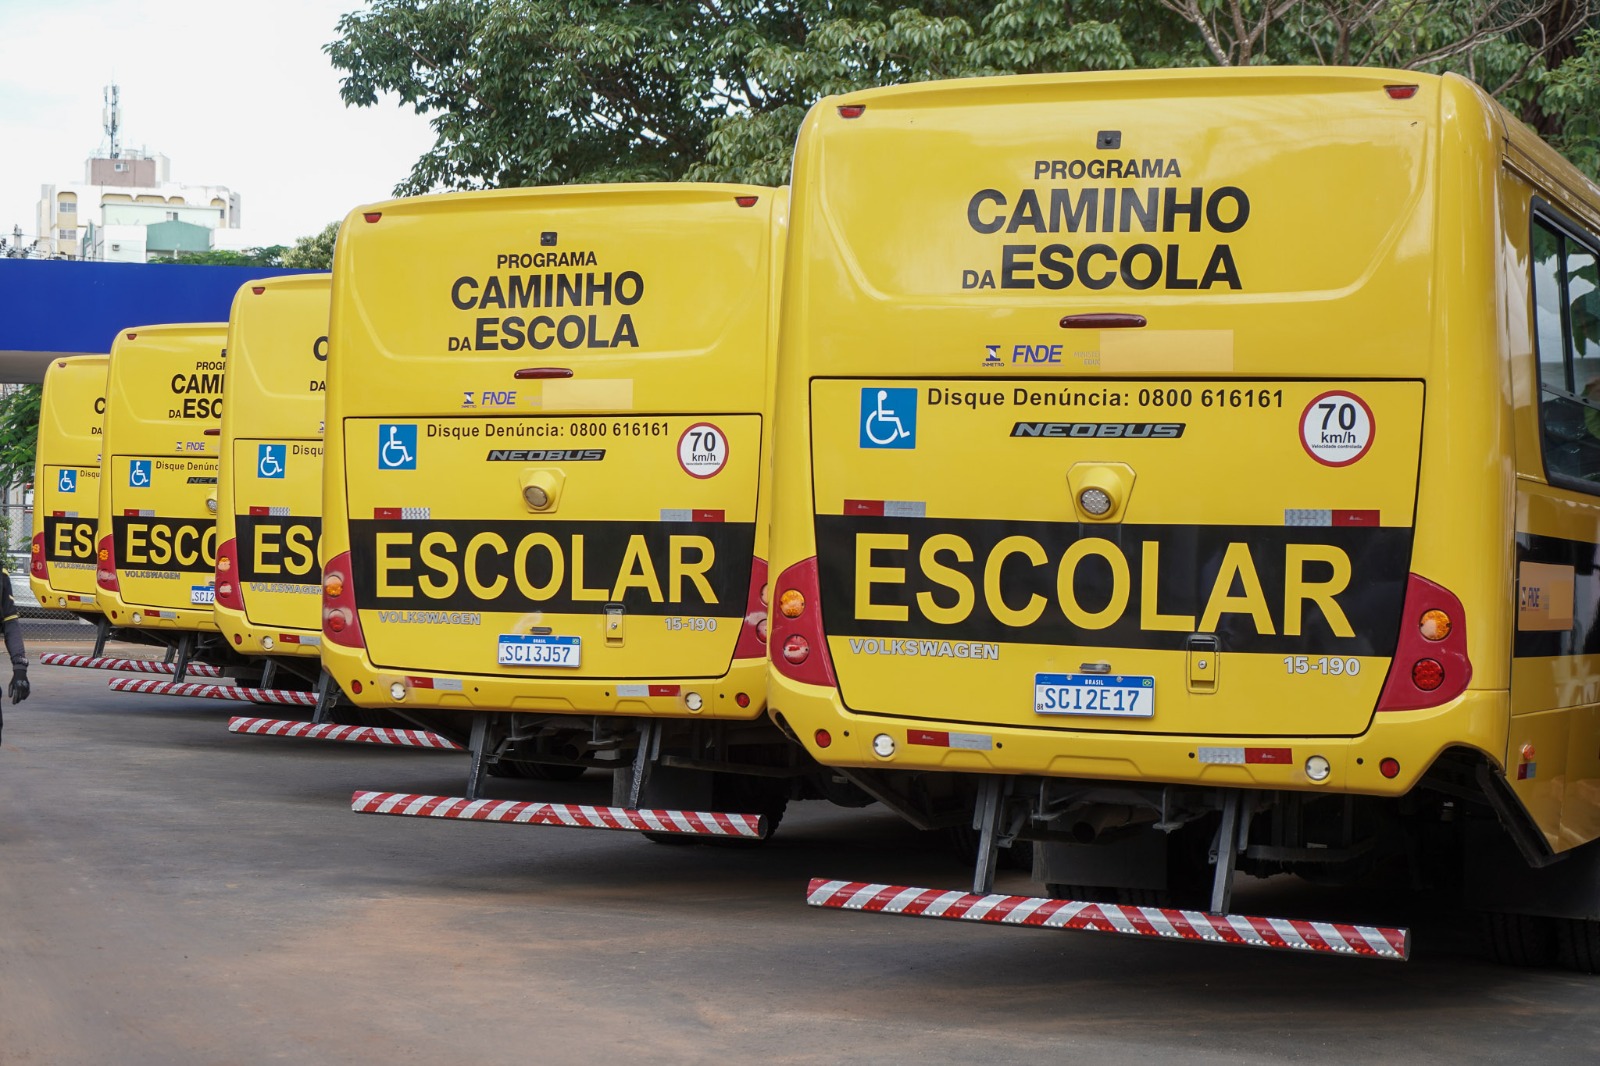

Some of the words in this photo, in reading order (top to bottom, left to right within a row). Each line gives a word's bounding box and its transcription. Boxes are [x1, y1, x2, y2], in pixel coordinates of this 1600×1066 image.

[1034, 158, 1182, 180] PROGRAMA
[967, 186, 1251, 234] CAMINHO
[497, 250, 598, 269] PROGRAMA
[962, 270, 997, 290] DA
[1001, 244, 1243, 290] ESCOLA
[451, 271, 645, 311] CAMINHO
[448, 336, 472, 352] DA
[474, 314, 640, 351] ESCOLA
[1011, 344, 1064, 363] FNDE
[481, 391, 518, 405] FNDE
[927, 387, 1005, 410] Disque
[1013, 387, 1129, 407] Denúncia:
[1138, 388, 1193, 408] 0800
[1201, 389, 1283, 408] 616161
[168, 409, 182, 419] DA
[1318, 403, 1357, 431] 70
[91, 427, 103, 435] DA
[427, 423, 480, 441] Disque
[485, 422, 565, 437] Denúncia:
[570, 422, 607, 437] 0800
[612, 421, 669, 437] 616161
[1013, 423, 1183, 438] NEOBUS
[1321, 431, 1356, 443] km/h
[690, 431, 716, 452] 70
[489, 450, 602, 461] NEOBUS
[692, 452, 716, 462] km/h
[155, 461, 185, 472] Disque
[124, 570, 181, 580] VOLKSWAGEN
[374, 531, 720, 605] ESCOLAR
[853, 532, 1356, 639] ESCOLAR
[378, 611, 481, 625] VOLKSWAGEN
[665, 617, 717, 632] 15-190
[505, 645, 571, 663] SCI3J57
[849, 638, 1000, 661] VOLKSWAGEN
[1283, 655, 1361, 677] 15-190
[1084, 678, 1104, 686] BRASIL
[1044, 687, 1140, 711] SCI2E17
